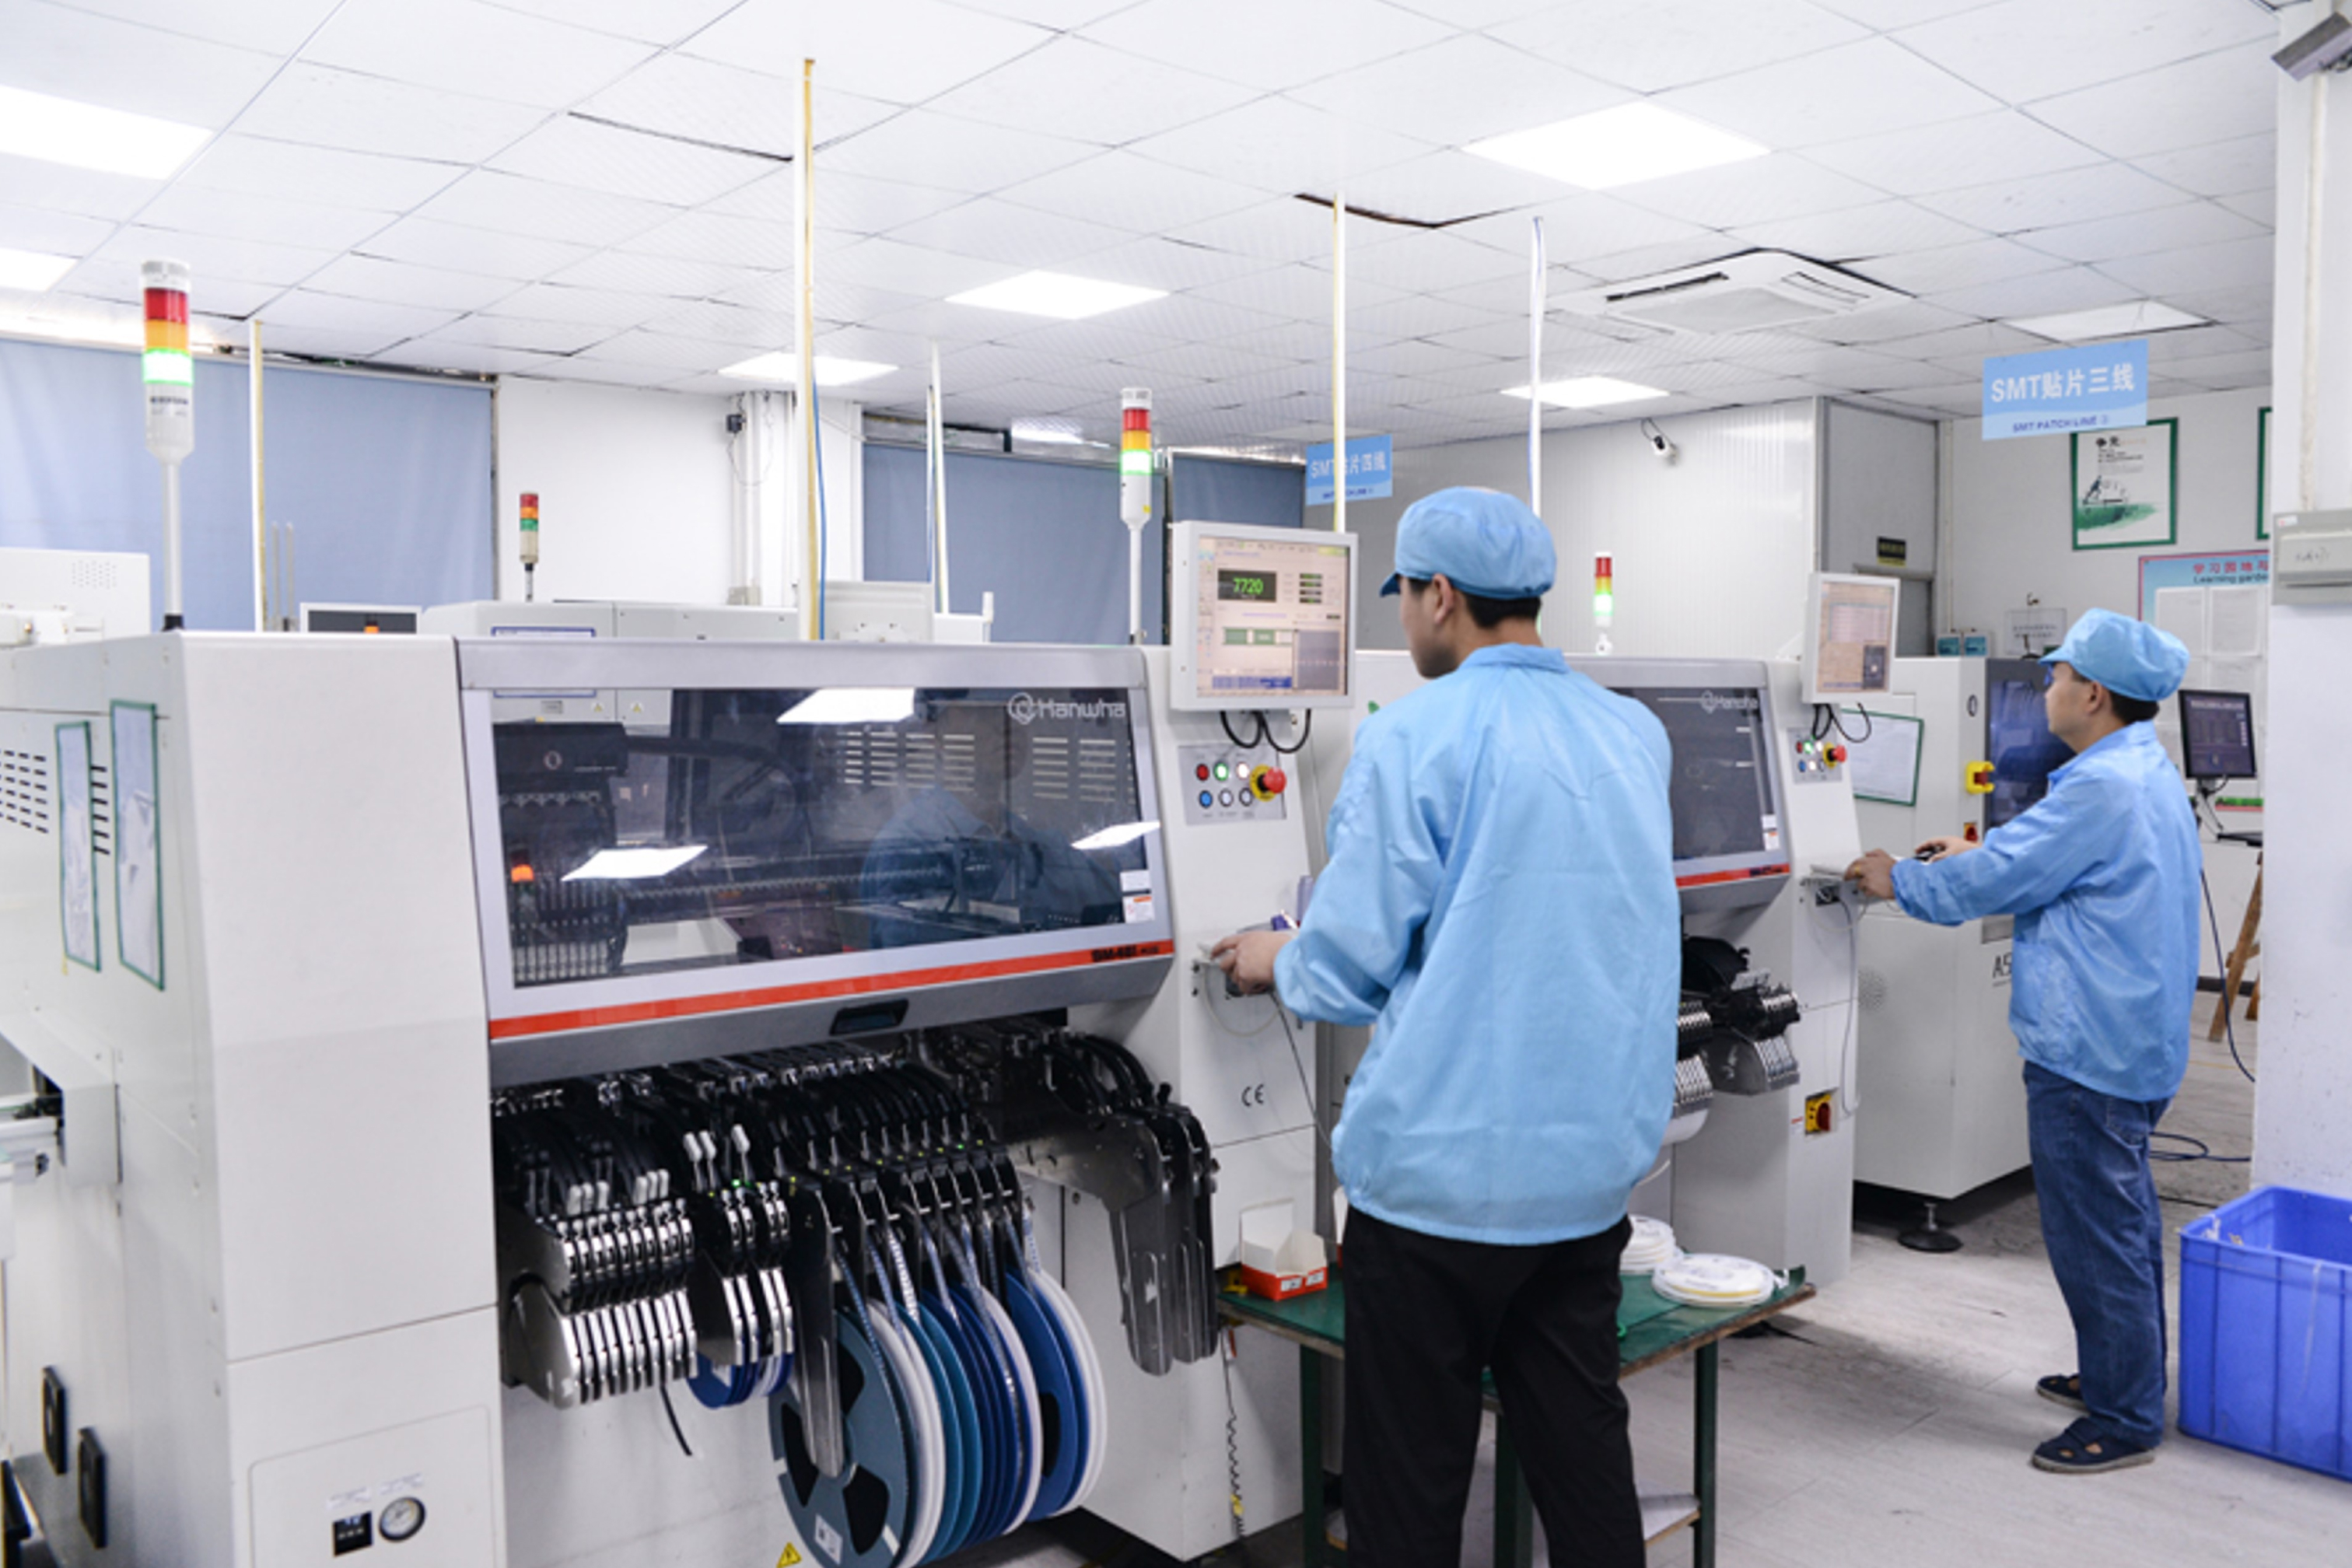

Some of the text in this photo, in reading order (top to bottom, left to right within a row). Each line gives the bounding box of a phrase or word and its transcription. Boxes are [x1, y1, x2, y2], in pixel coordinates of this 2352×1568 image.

[1991, 362, 2134, 402] SMT贴片三线
[1233, 576, 1264, 595] 7720
[1038, 698, 1126, 719] Hanwha
[1241, 1083, 1264, 1107] CE
